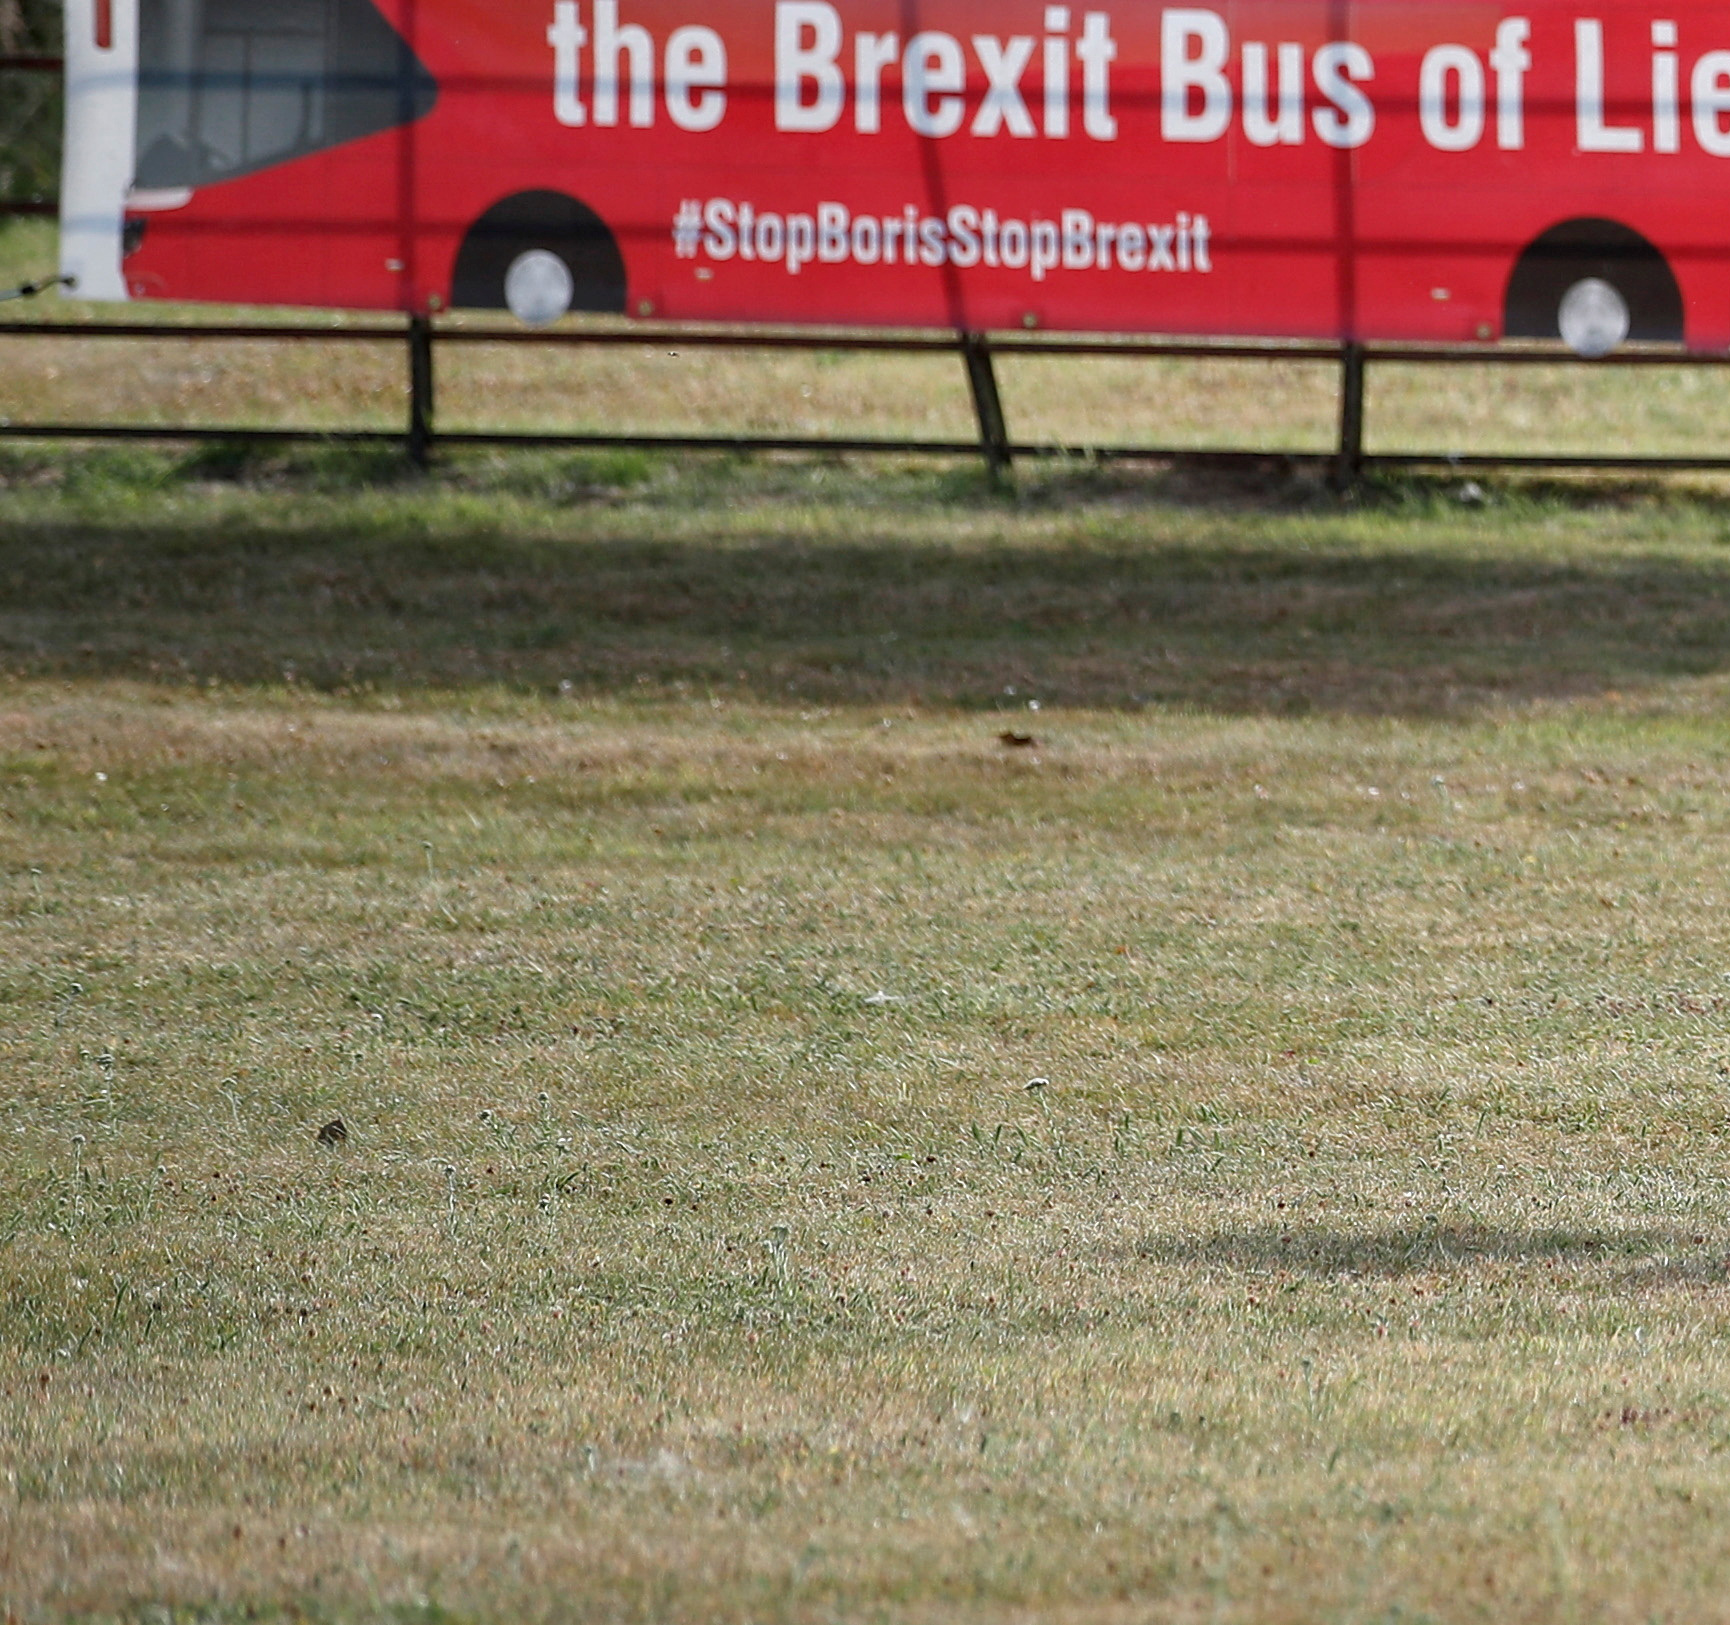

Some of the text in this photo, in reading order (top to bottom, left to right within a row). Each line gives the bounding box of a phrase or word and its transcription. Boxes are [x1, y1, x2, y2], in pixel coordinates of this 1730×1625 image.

[1160, 8, 1374, 148] Bus
[1419, 17, 1531, 151] of
[674, 199, 1211, 281] #StopBorisStopBrexit
